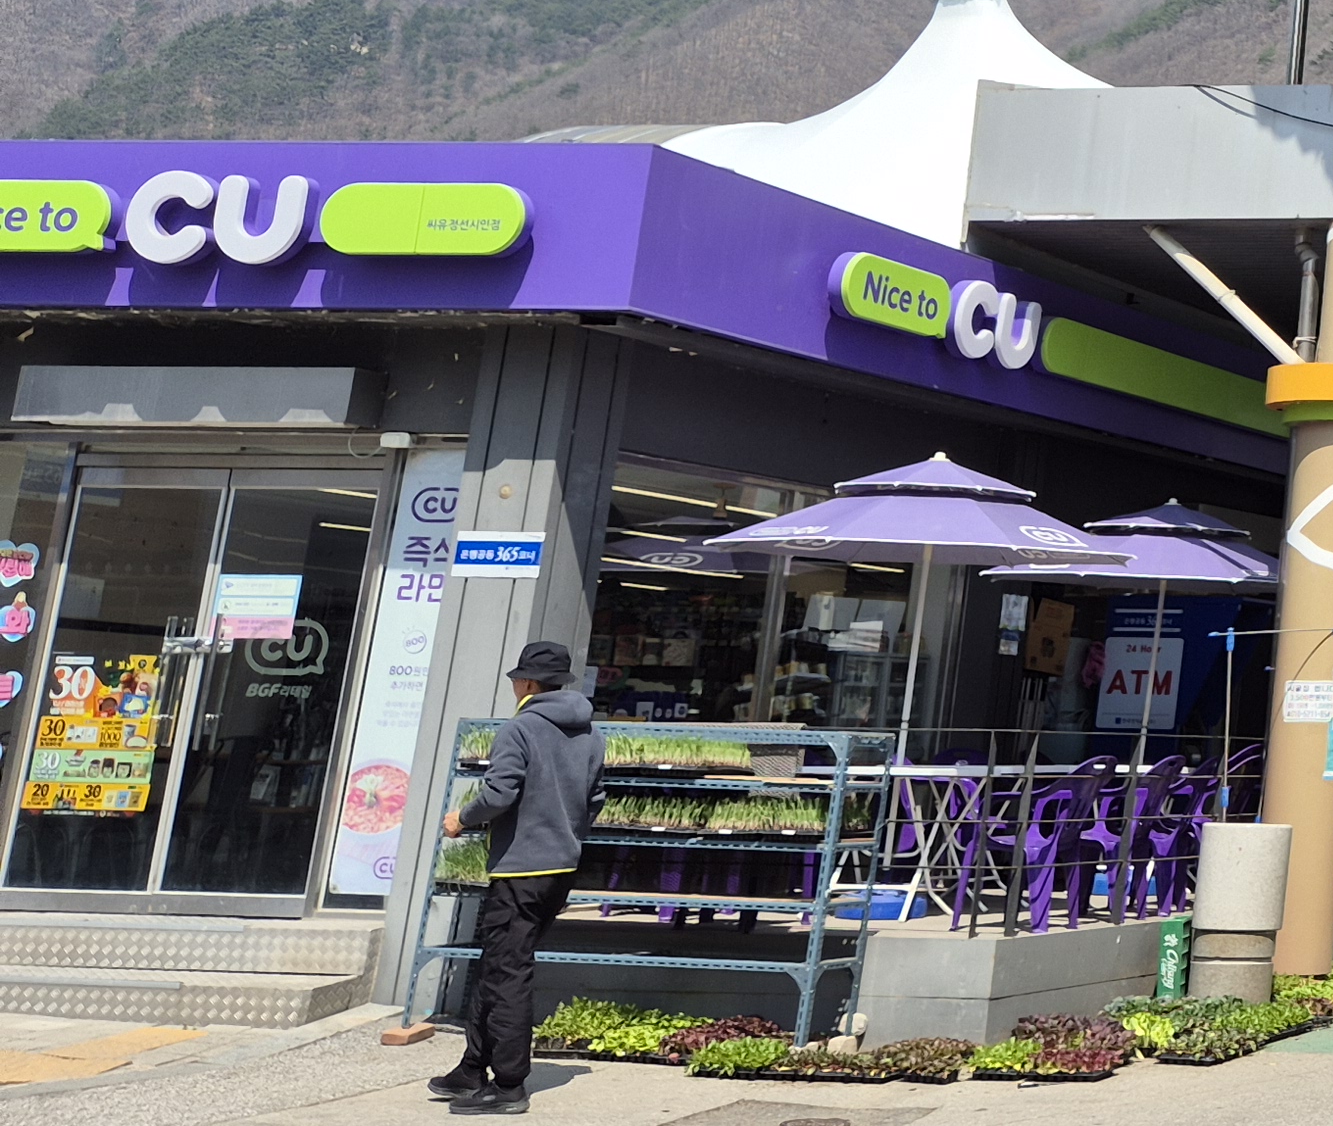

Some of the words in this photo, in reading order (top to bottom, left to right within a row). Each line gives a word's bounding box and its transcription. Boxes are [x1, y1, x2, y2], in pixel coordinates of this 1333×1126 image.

[39, 201, 79, 232] to
[126, 170, 312, 265] CU
[863, 270, 912, 313] Nice
[917, 289, 939, 320] to
[954, 280, 1043, 369] CU
[423, 496, 458, 515] CU
[261, 634, 313, 661] CU
[1126, 645, 1137, 653] 24
[1141, 645, 1161, 653] Hor
[1106, 669, 1173, 695] ATM
